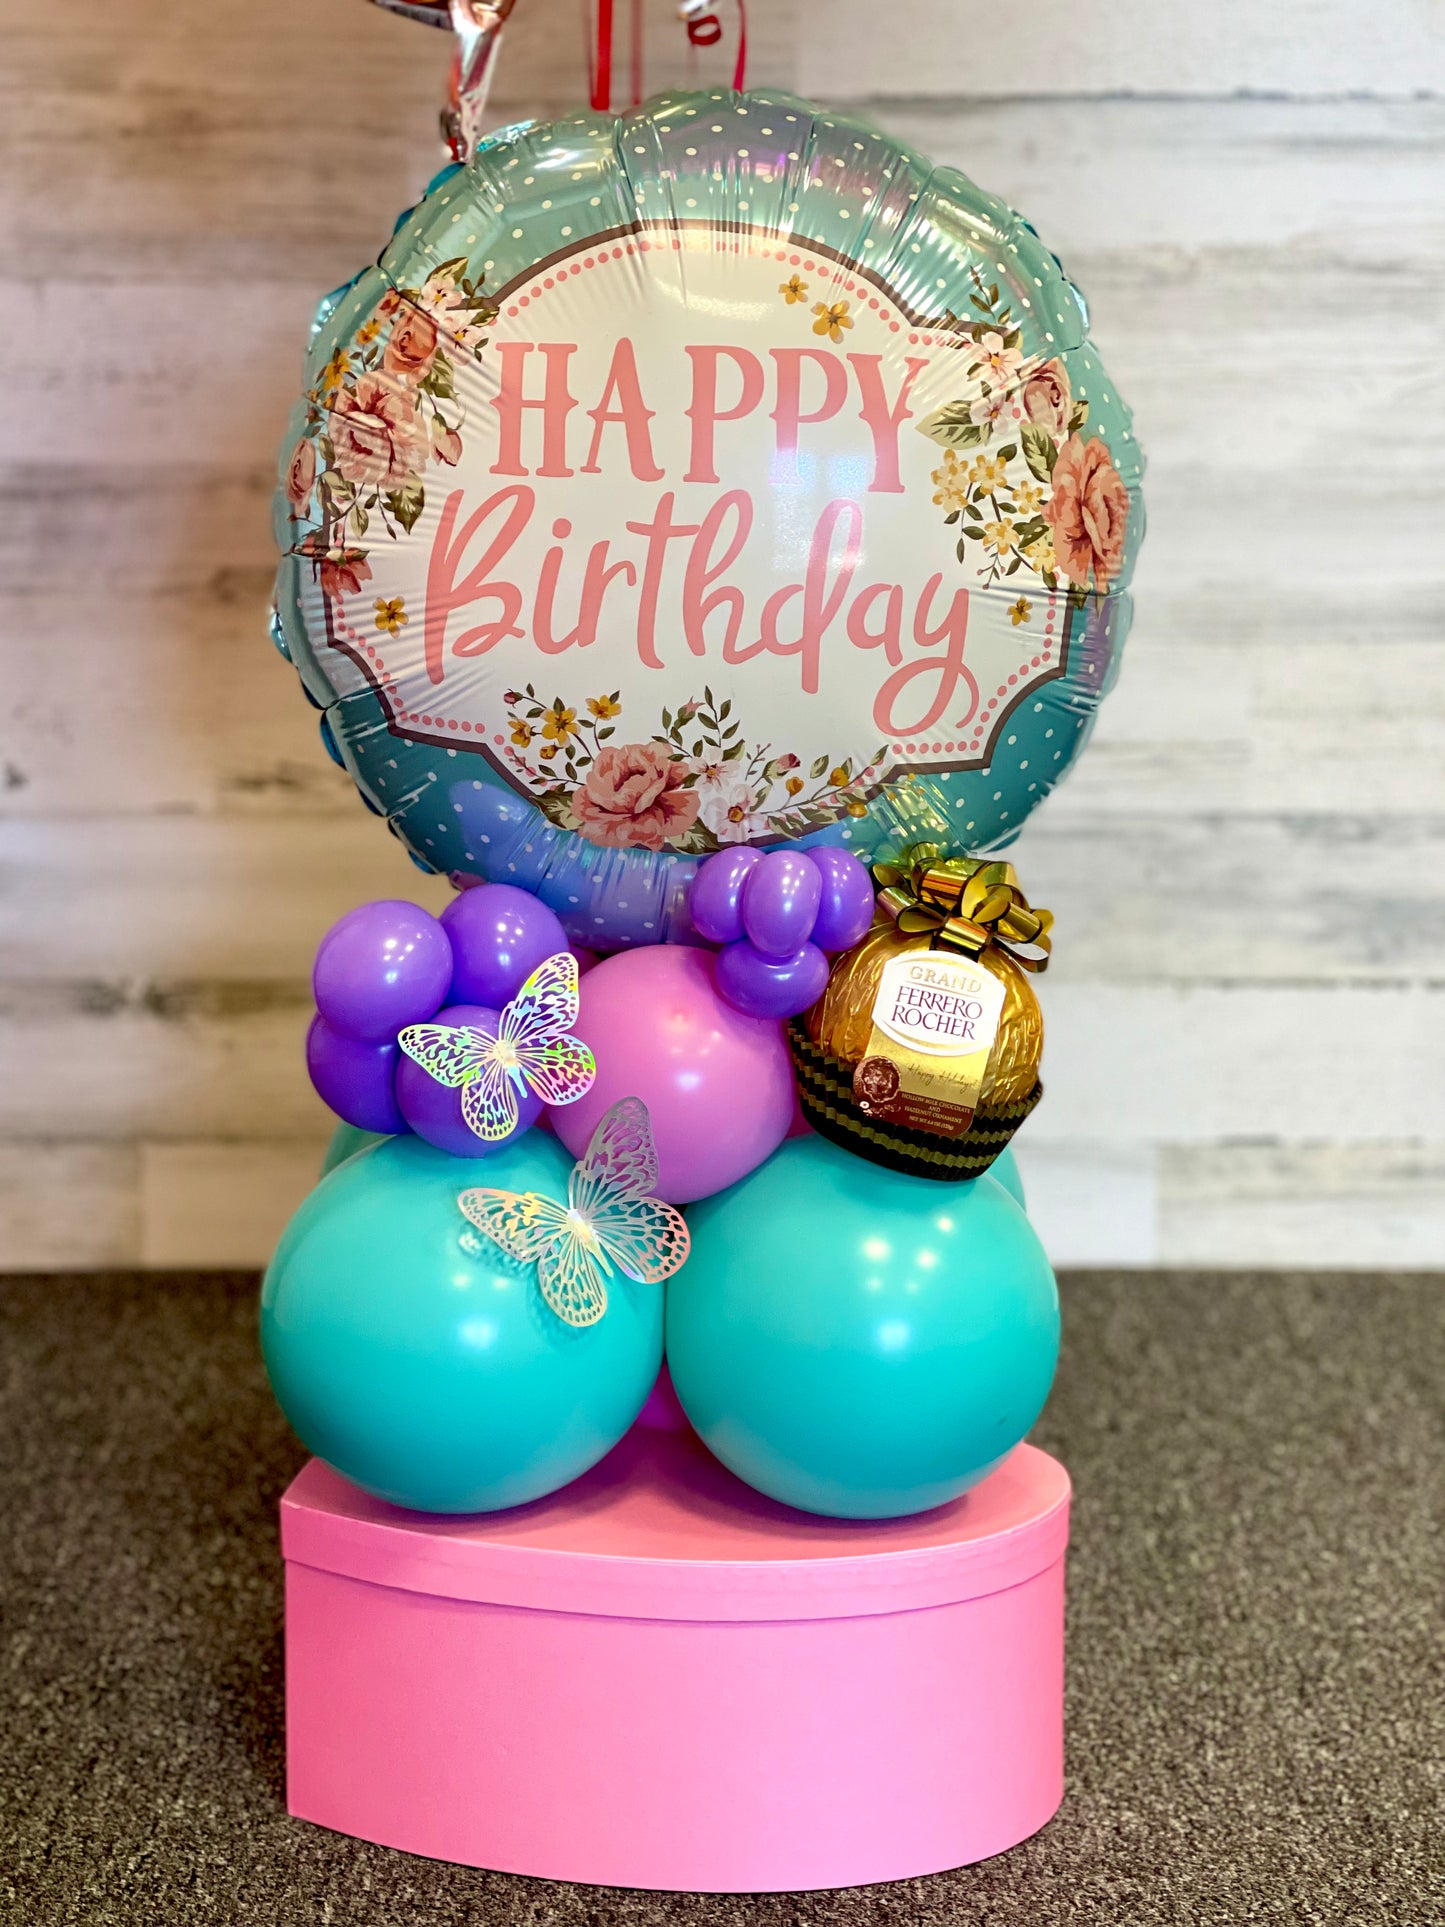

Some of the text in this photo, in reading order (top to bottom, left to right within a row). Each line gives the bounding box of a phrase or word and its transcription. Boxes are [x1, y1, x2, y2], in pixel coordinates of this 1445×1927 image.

[489, 337, 930, 493] HAPPY
[424, 484, 979, 737] Birthday
[909, 965, 982, 993] GRAND
[896, 985, 983, 1020] FERRERO
[891, 1004, 976, 1041] ROCHER
[907, 1063, 935, 1087] Happy
[901, 1092, 971, 1114] HOLLOW MILK CHOCOLATE
[904, 1105, 963, 1124] HAZELNUT ORNAMENT
[928, 1105, 941, 1113] AND
